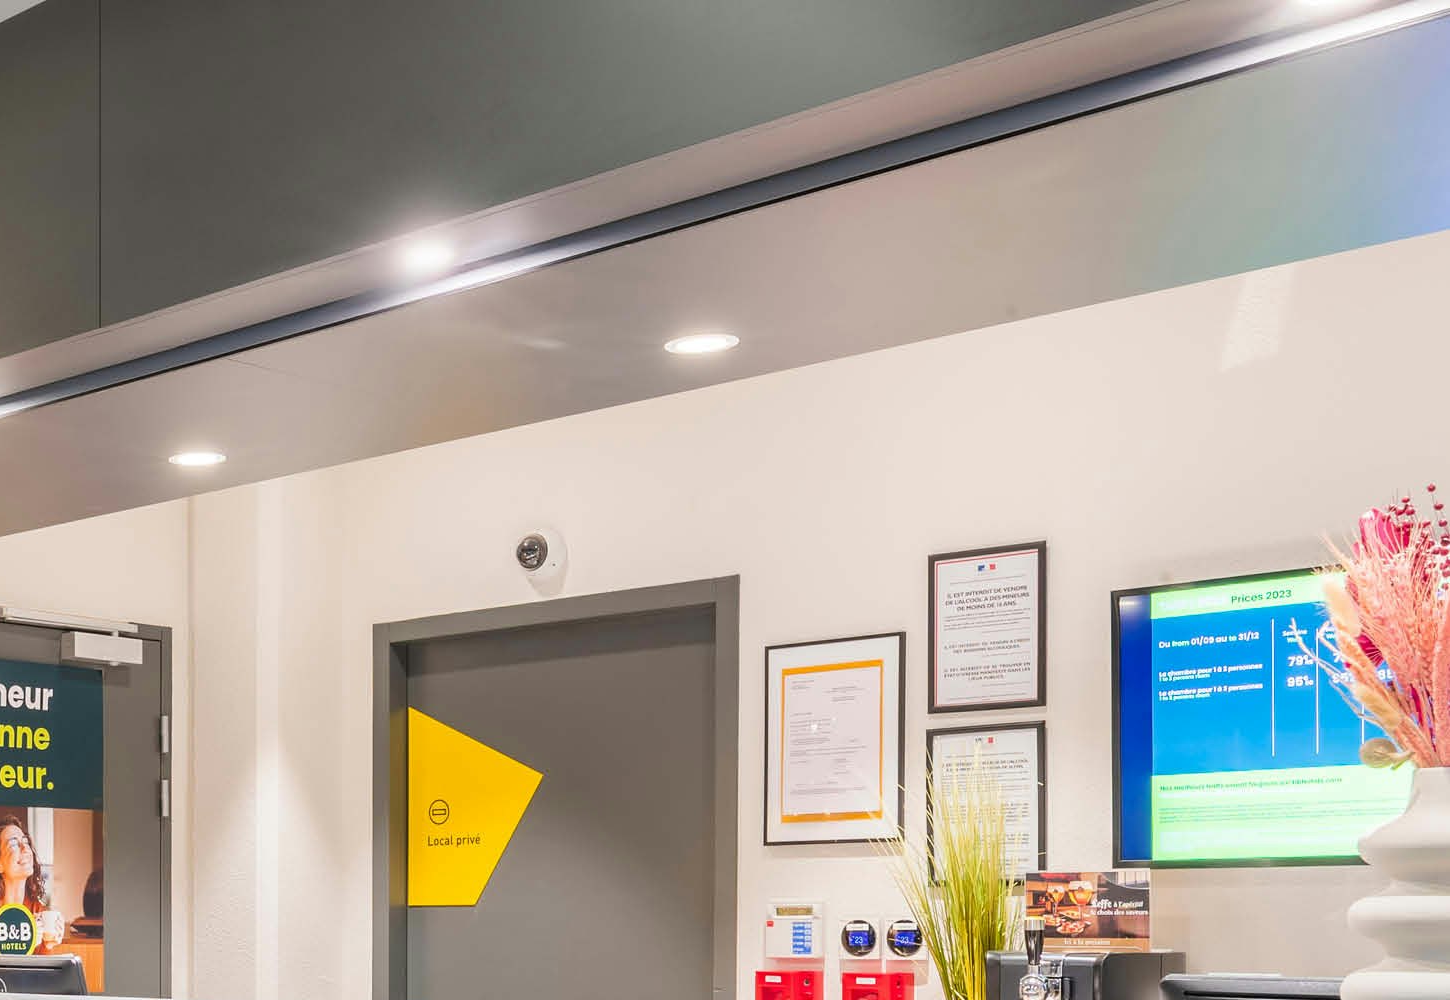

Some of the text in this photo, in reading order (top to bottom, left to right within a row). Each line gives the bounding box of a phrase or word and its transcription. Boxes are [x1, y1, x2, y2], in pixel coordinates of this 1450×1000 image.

[965, 589, 993, 597] INTERDIT
[1002, 592, 1030, 600] MINEURS
[1231, 592, 1263, 605] Prices
[1266, 589, 1292, 600] 2023
[1158, 641, 1171, 649] Du
[1172, 639, 1190, 647] from
[1238, 631, 1260, 642] 31/12
[427, 832, 481, 848] Local privé
[855, 936, 863, 944] 23
[1, 942, 27, 950] HOTELS
